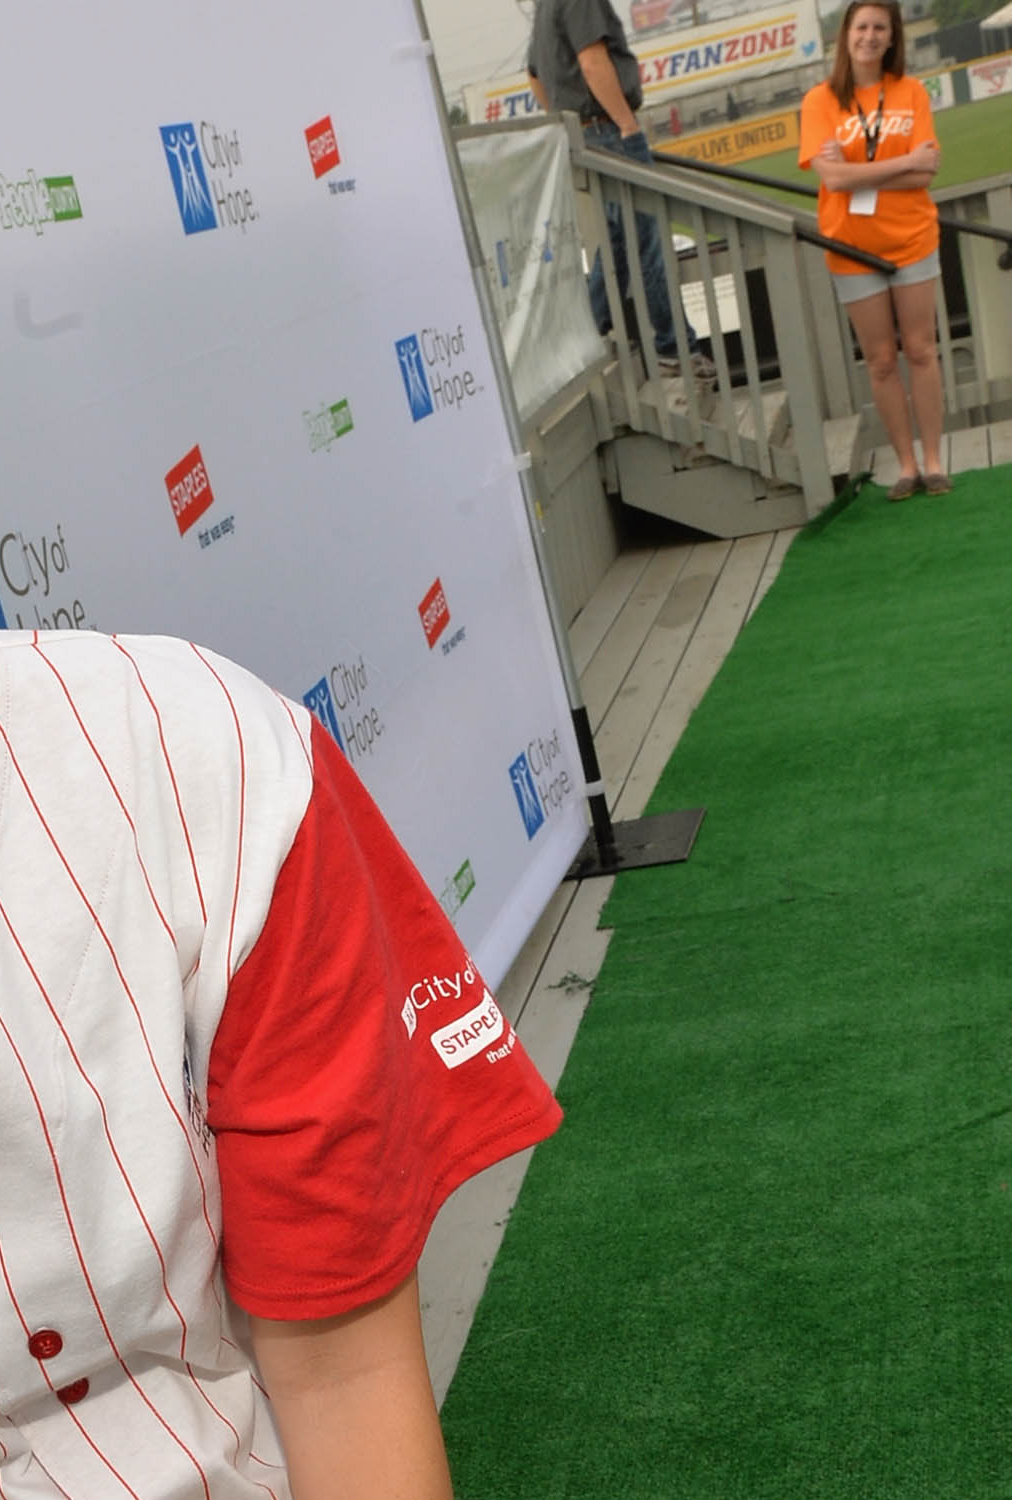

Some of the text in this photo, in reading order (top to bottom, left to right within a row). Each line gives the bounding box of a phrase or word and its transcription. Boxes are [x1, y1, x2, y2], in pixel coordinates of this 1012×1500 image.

[701, 134, 734, 159] LIVE
[735, 121, 787, 151] UNITED
[211, 179, 256, 235] Hope
[420, 324, 465, 369] City of
[429, 370, 478, 411] Hope
[330, 661, 362, 711] City
[341, 706, 382, 764] Hope
[409, 971, 463, 1010] City
